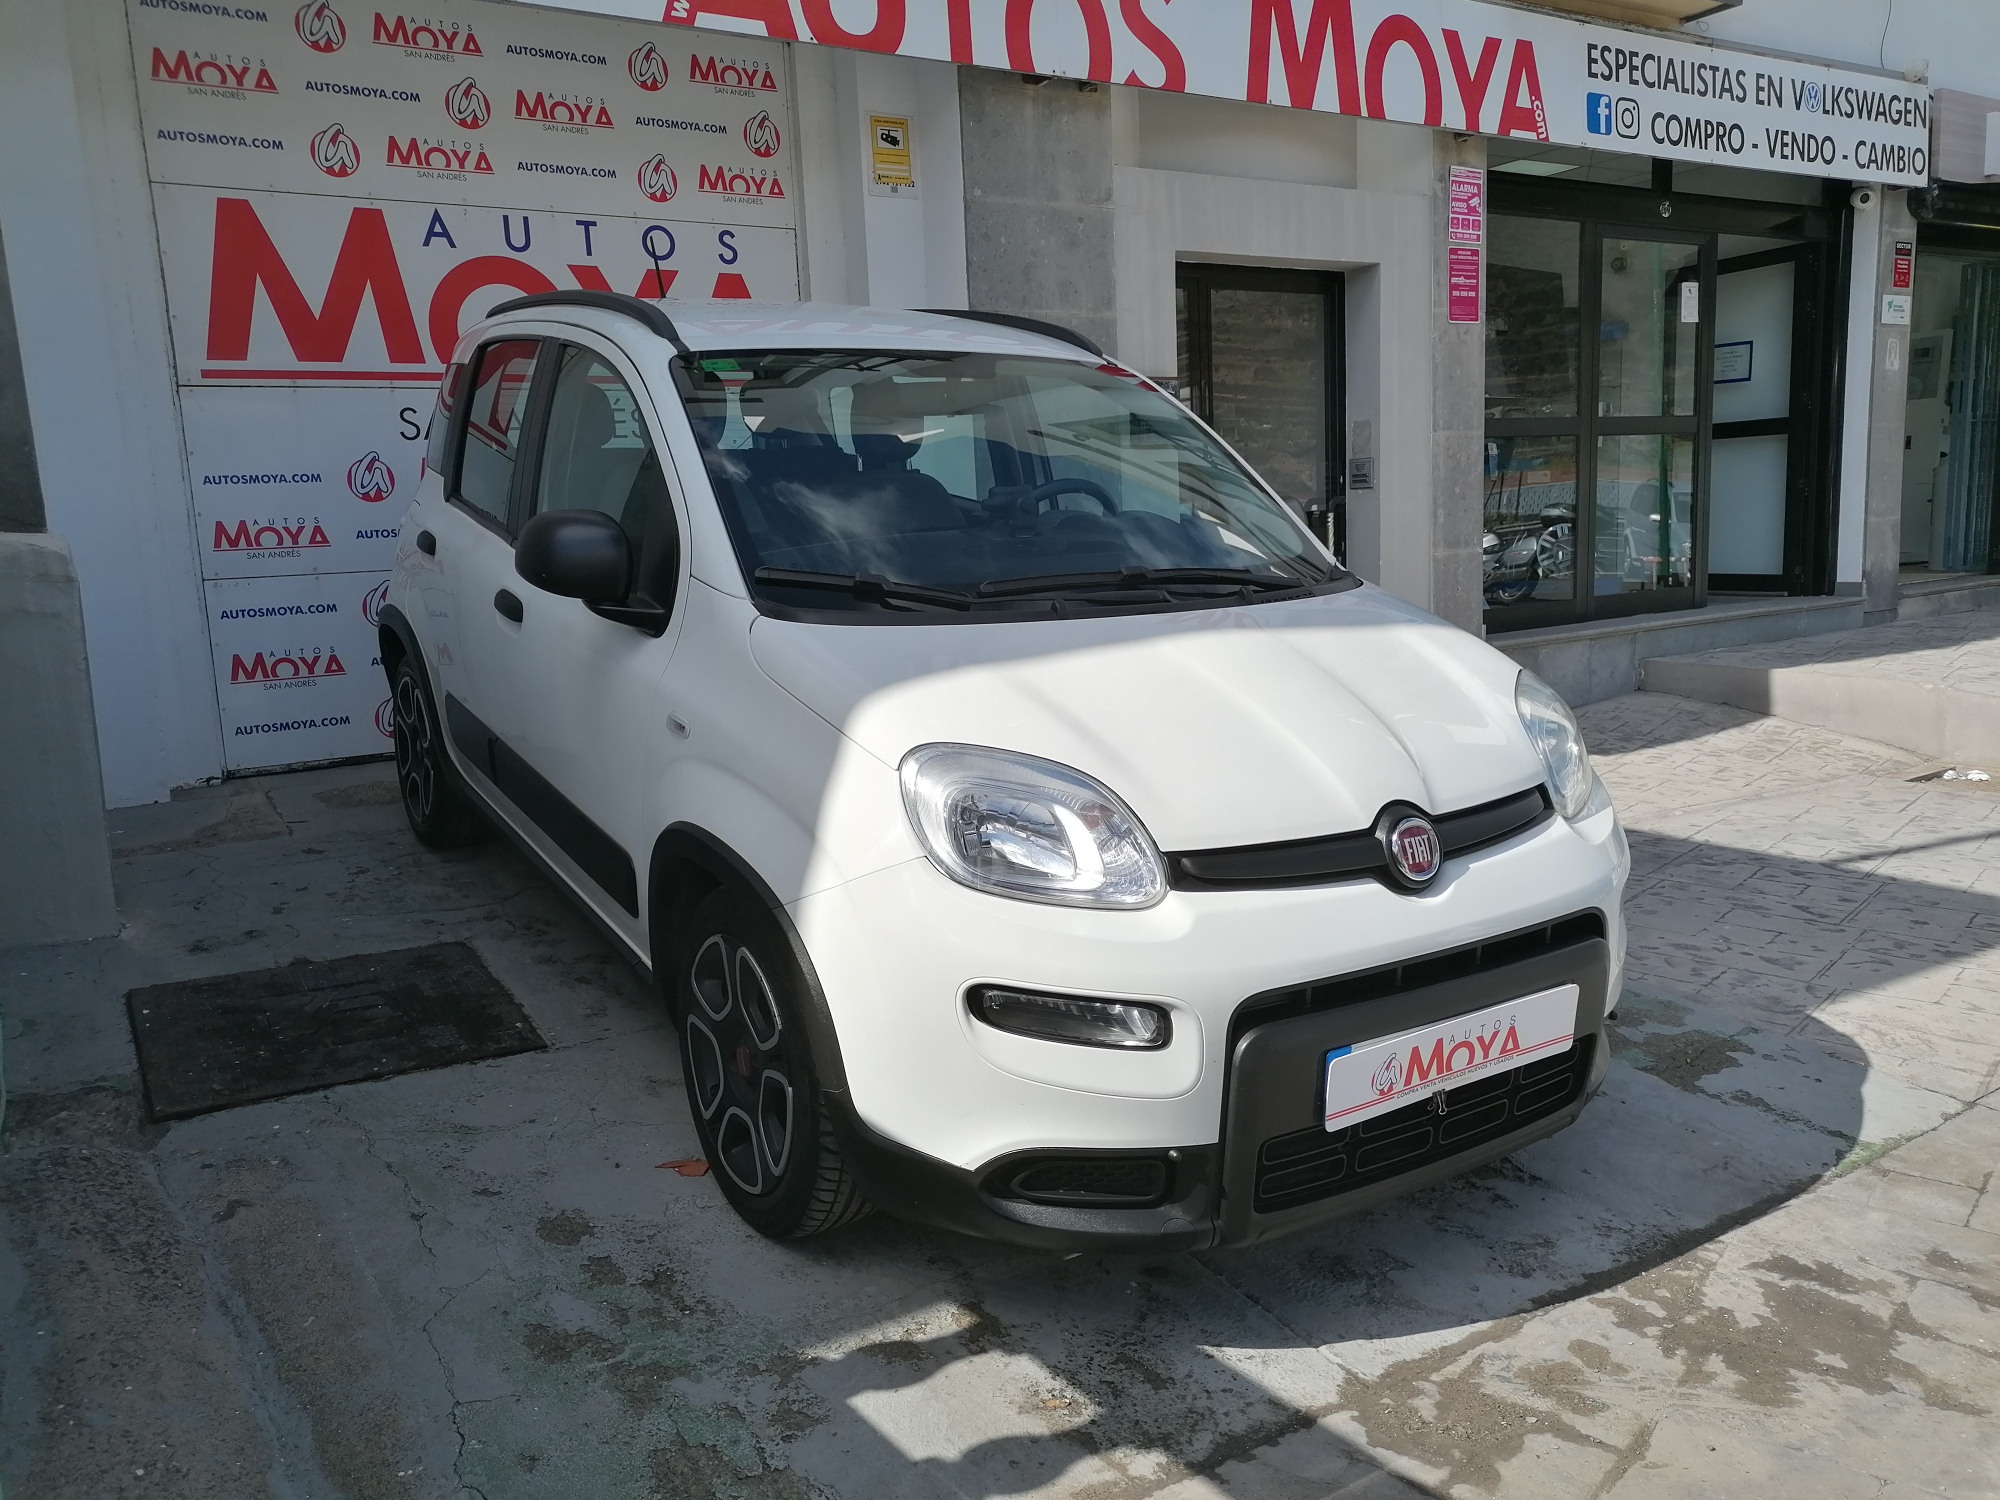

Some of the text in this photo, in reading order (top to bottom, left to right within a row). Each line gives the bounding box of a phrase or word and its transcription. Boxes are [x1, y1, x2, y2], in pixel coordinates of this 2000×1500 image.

[139, 0, 268, 22] AUTOSMOYA.COM
[372, 12, 483, 55] MOYA
[410, 16, 472, 32] AUTOS
[193, 51, 266, 67] AUTOS
[404, 50, 421, 59] SAN
[506, 44, 607, 66] AUTOSMOYA.COM
[719, 57, 770, 70] AUTOS
[151, 47, 278, 91] MOYA
[690, 53, 778, 90] MOYA
[1246, 0, 1550, 142] MOYA
[1587, 43, 1747, 103] ESPECIALISTAS
[1755, 73, 1784, 108] EN
[187, 87, 209, 96] SAN
[305, 80, 421, 103] AUTOSMOYA.COM
[548, 92, 605, 105] AUTOS
[713, 86, 728, 95] SAN
[515, 90, 614, 127] MOYA
[1531, 95, 1547, 139] .com
[542, 123, 559, 132] SAN
[635, 116, 728, 135] AUTOSMOYA.COM
[157, 129, 284, 151] AUTOSMOYA.COM
[423, 138, 485, 151] AUTOS
[1651, 112, 1745, 155] COMPRO
[1765, 127, 1836, 166] VENDO
[1855, 140, 1926, 176] CAMBIO
[386, 135, 494, 173] MOYA
[417, 170, 434, 180] SAN
[517, 161, 617, 179] AUTOSMOYA.COM
[728, 166, 777, 178] AUTOS
[698, 164, 785, 197] MOYA
[1452, 183, 1478, 194] ALARMA
[722, 195, 737, 203] SAN
[422, 207, 738, 265] AUTOS
[203, 473, 322, 485] AUTOSMOYA.COM
[253, 516, 319, 526] AUTOS
[213, 519, 331, 549] MOYA
[356, 528, 400, 539] AUTOS
[246, 551, 266, 559] SAN
[220, 603, 338, 620] AUTOSMOYA.COM
[269, 645, 335, 658] AUTOS
[230, 652, 346, 681] MOYA
[263, 683, 282, 691] SAN
[234, 716, 350, 736] AUTOSMOYA.COM
[1404, 835, 1431, 864] FIAT
[1449, 1015, 1516, 1045] AUTOS
[1403, 1025, 1521, 1088] MOYA
[1396, 1088, 1419, 1099] COMPRA
[1420, 1081, 1437, 1091] VENTA
[1467, 1064, 1488, 1075] NUEVOS
[1493, 1055, 1514, 1066] USADOS
